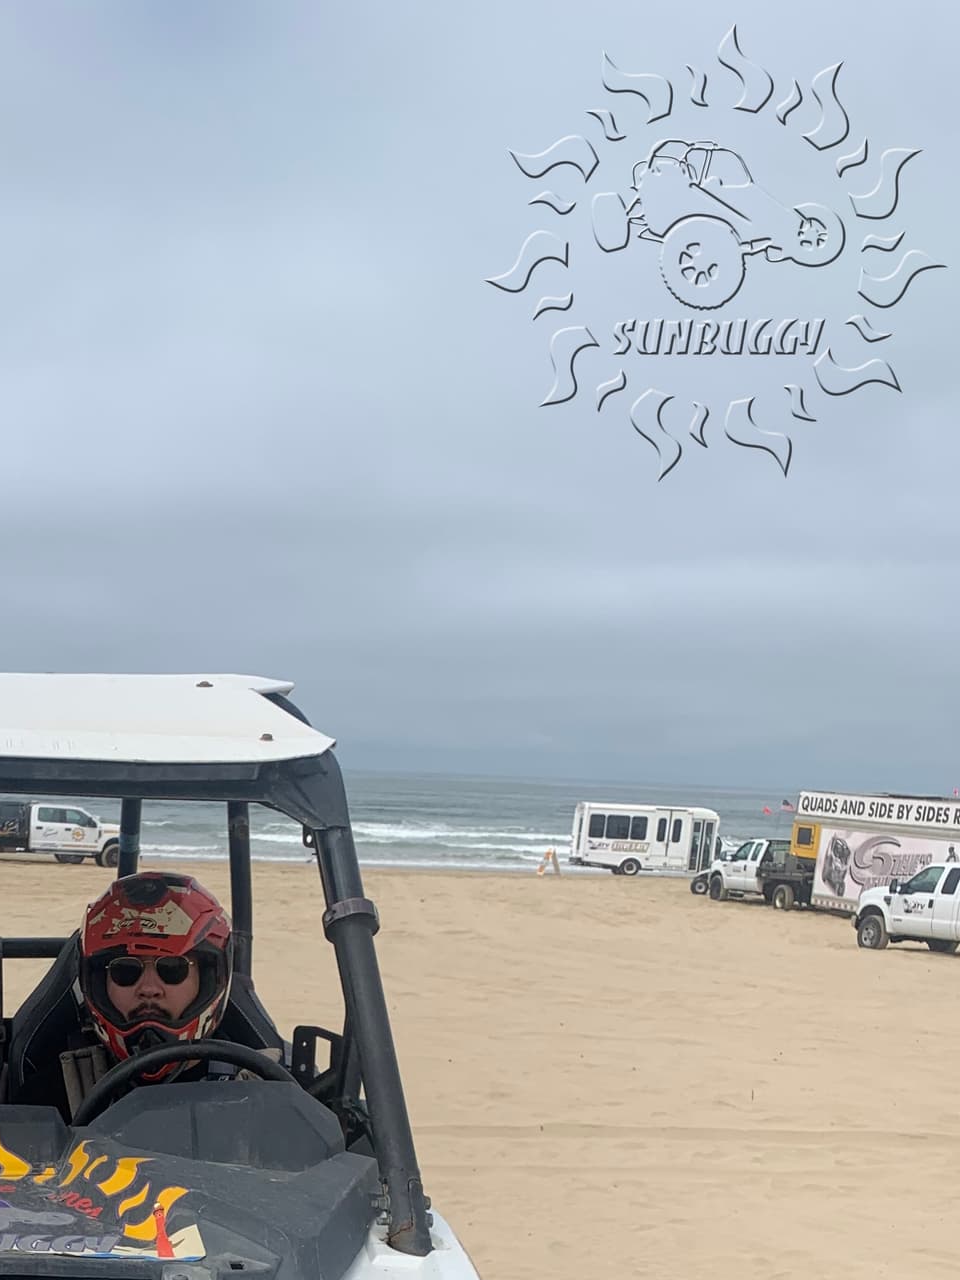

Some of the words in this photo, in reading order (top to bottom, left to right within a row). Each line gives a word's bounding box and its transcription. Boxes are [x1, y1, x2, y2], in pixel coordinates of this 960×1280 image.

[801, 796, 838, 813] QUADS
[841, 799, 865, 816] AND
[868, 802, 893, 819] SIDE
[897, 804, 913, 821] BY
[915, 805, 949, 824] SIDES
